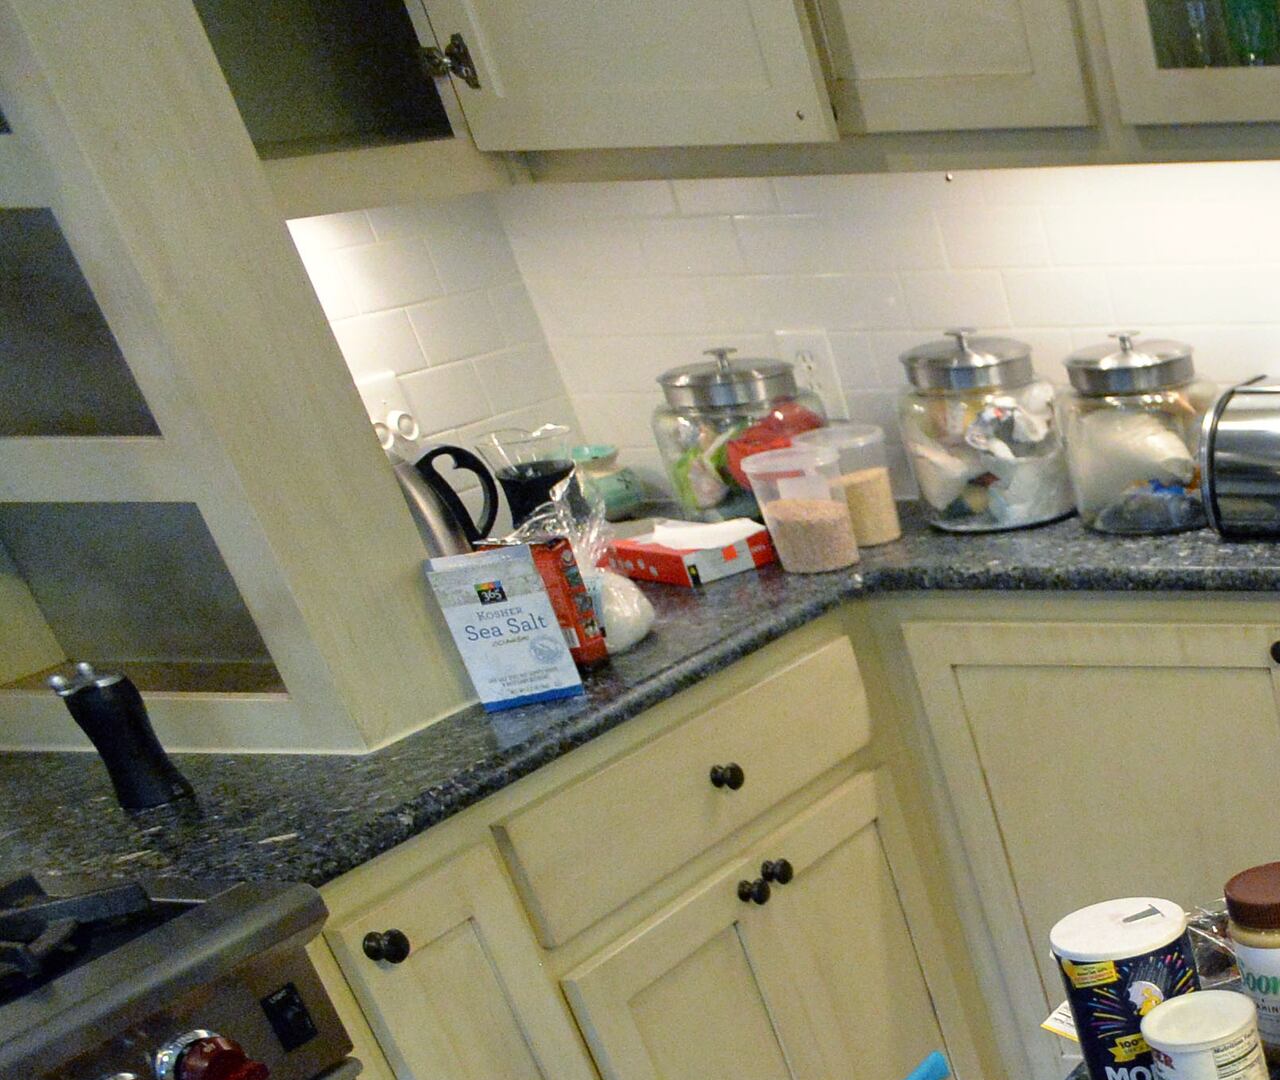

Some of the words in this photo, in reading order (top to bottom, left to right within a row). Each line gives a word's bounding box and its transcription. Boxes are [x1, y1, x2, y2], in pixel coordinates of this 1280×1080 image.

[481, 590, 503, 601] 365
[476, 607, 523, 621] KOSHER
[465, 624, 503, 641] Sea
[506, 614, 548, 634] Salt
